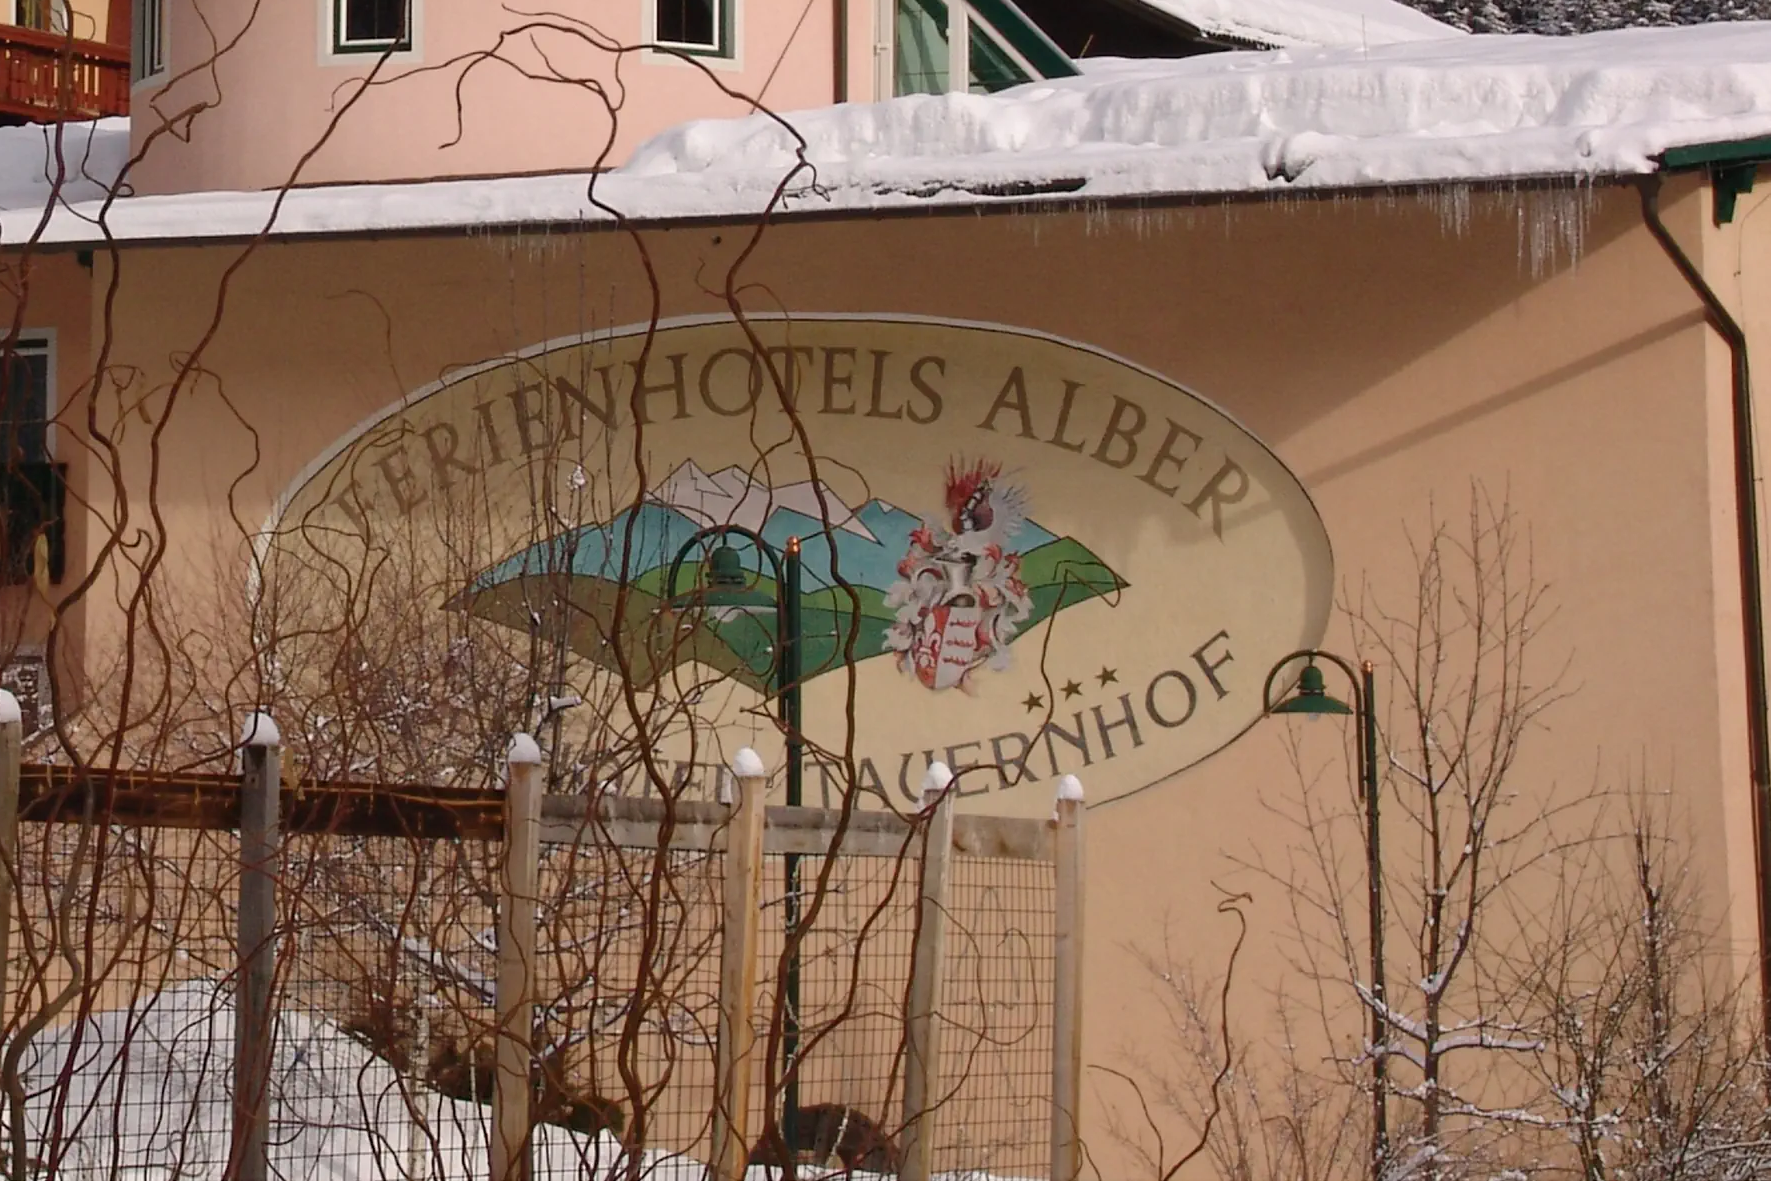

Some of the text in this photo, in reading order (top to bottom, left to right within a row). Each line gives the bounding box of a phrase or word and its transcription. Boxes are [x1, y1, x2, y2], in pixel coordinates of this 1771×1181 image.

[332, 344, 1250, 542] FERIENHOTELS ALBER
[804, 630, 1235, 810] TAUERNHOF
